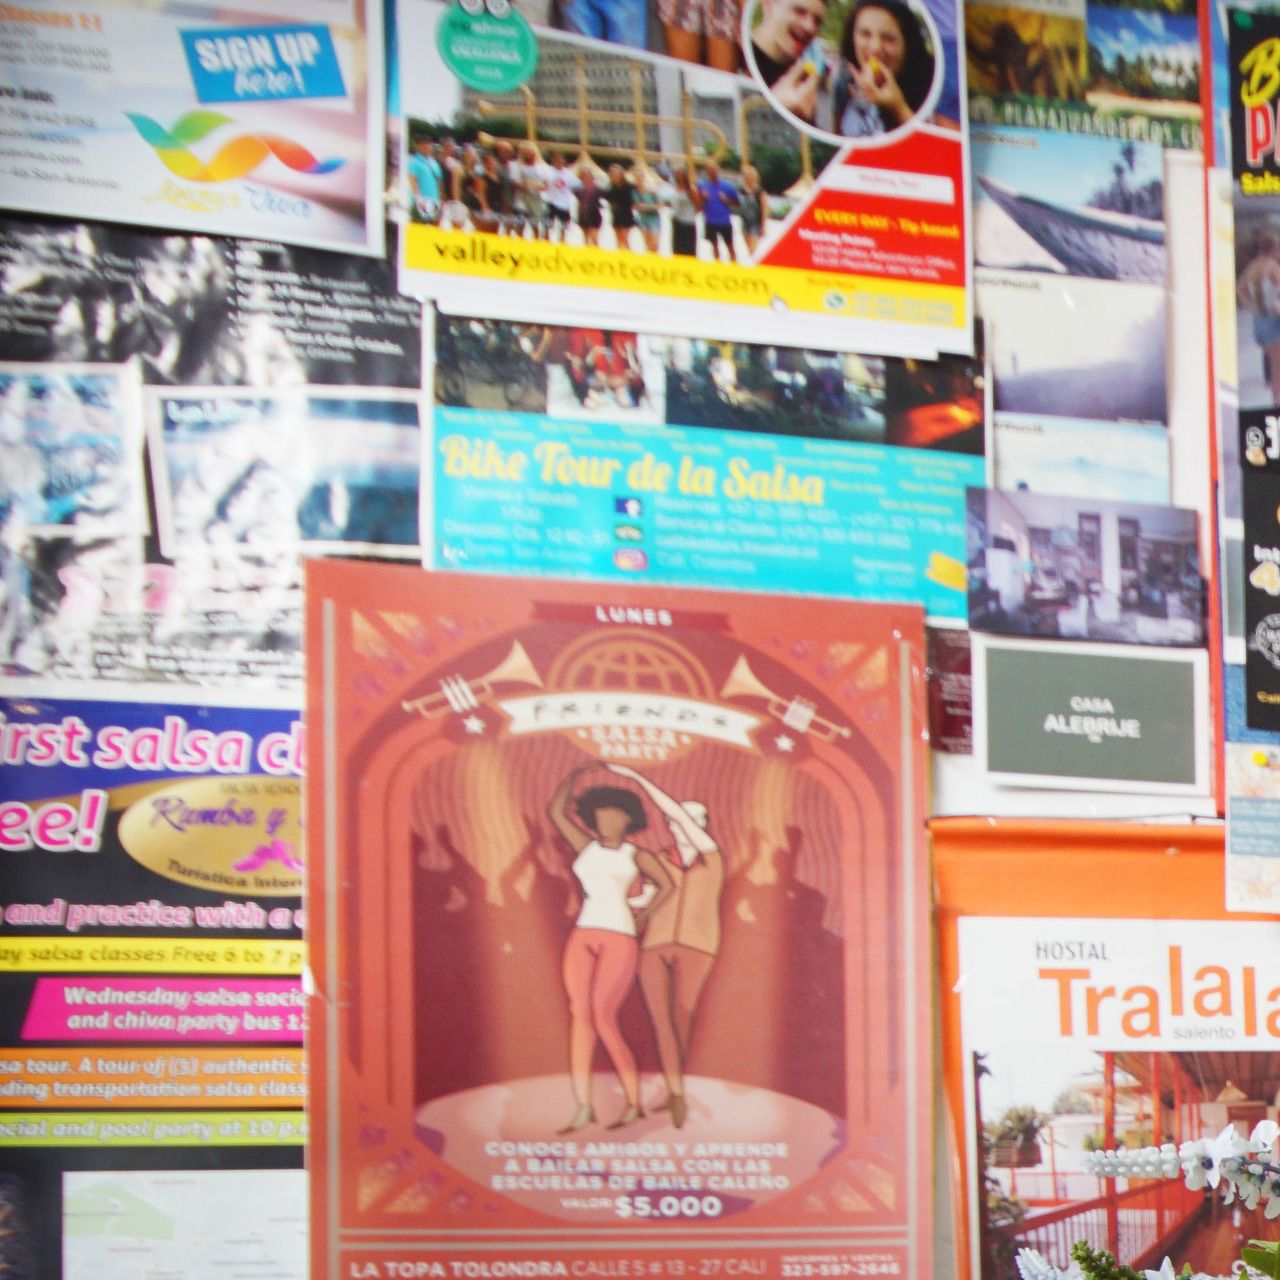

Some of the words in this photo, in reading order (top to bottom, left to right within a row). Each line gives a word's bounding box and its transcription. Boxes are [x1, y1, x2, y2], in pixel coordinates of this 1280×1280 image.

[194, 39, 274, 72] SIGN
[280, 33, 323, 67] UP
[431, 238, 771, 296] valleyadventours.com
[438, 433, 528, 477] Bike
[534, 440, 622, 489] Tour
[627, 455, 672, 493] de
[677, 458, 716, 494] la
[723, 458, 826, 506] Salsa
[595, 604, 673, 626] LUNES
[1070, 695, 1114, 716] CASA
[1044, 712, 1142, 740] ALEBRIJE
[93, 715, 253, 774] salsa
[1035, 941, 1110, 962] HOSTAL
[63, 987, 190, 1010] Wednesday
[194, 988, 250, 1007] salsa
[67, 1011, 109, 1029] and
[114, 1011, 172, 1030] chiva
[243, 1012, 281, 1030] bus
[614, 1194, 723, 1218] $5.000
[351, 1262, 380, 1278] LA
[384, 1262, 446, 1278] TOPA
[450, 1260, 568, 1278] TOLONDRA
